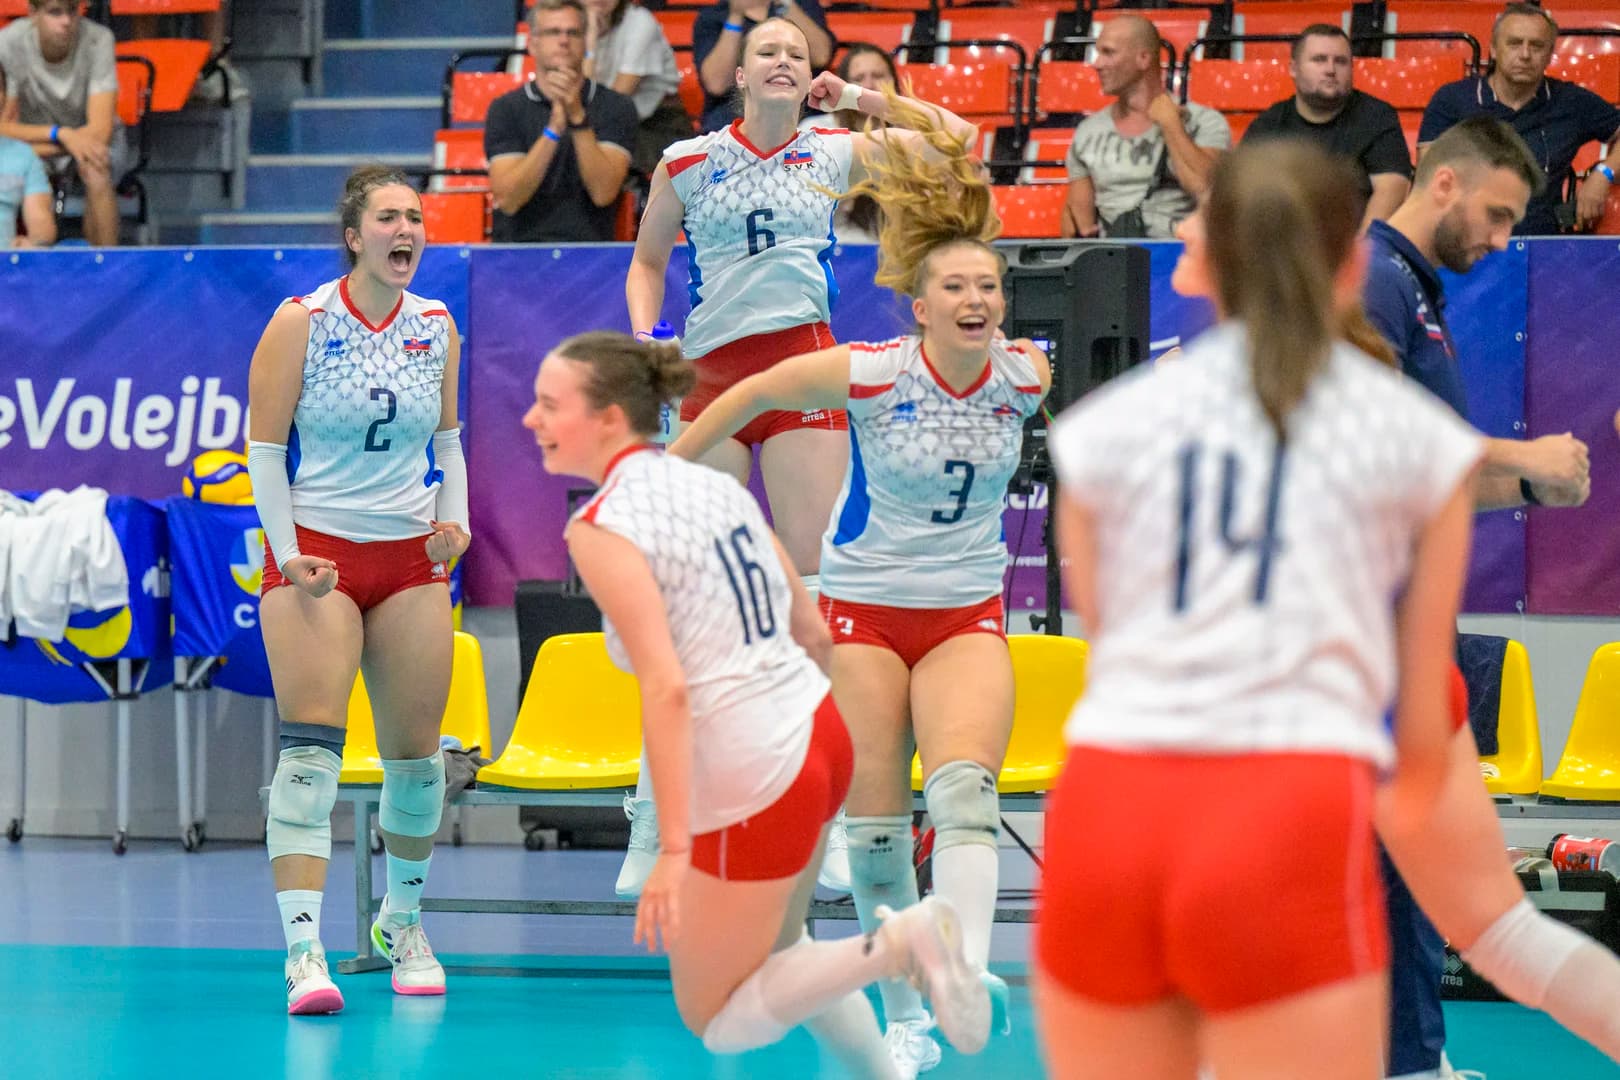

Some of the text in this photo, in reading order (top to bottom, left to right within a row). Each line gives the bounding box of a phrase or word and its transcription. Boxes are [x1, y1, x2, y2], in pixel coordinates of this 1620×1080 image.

[784, 162, 816, 172] SVK
[746, 208, 777, 256] 6
[0, 375, 250, 467] Volejb
[364, 388, 397, 451] 2
[802, 412, 825, 423] errea
[931, 460, 975, 523] 3
[1172, 440, 1289, 613] 14
[714, 523, 777, 645] 16
[1440, 974, 1463, 987] rrea
